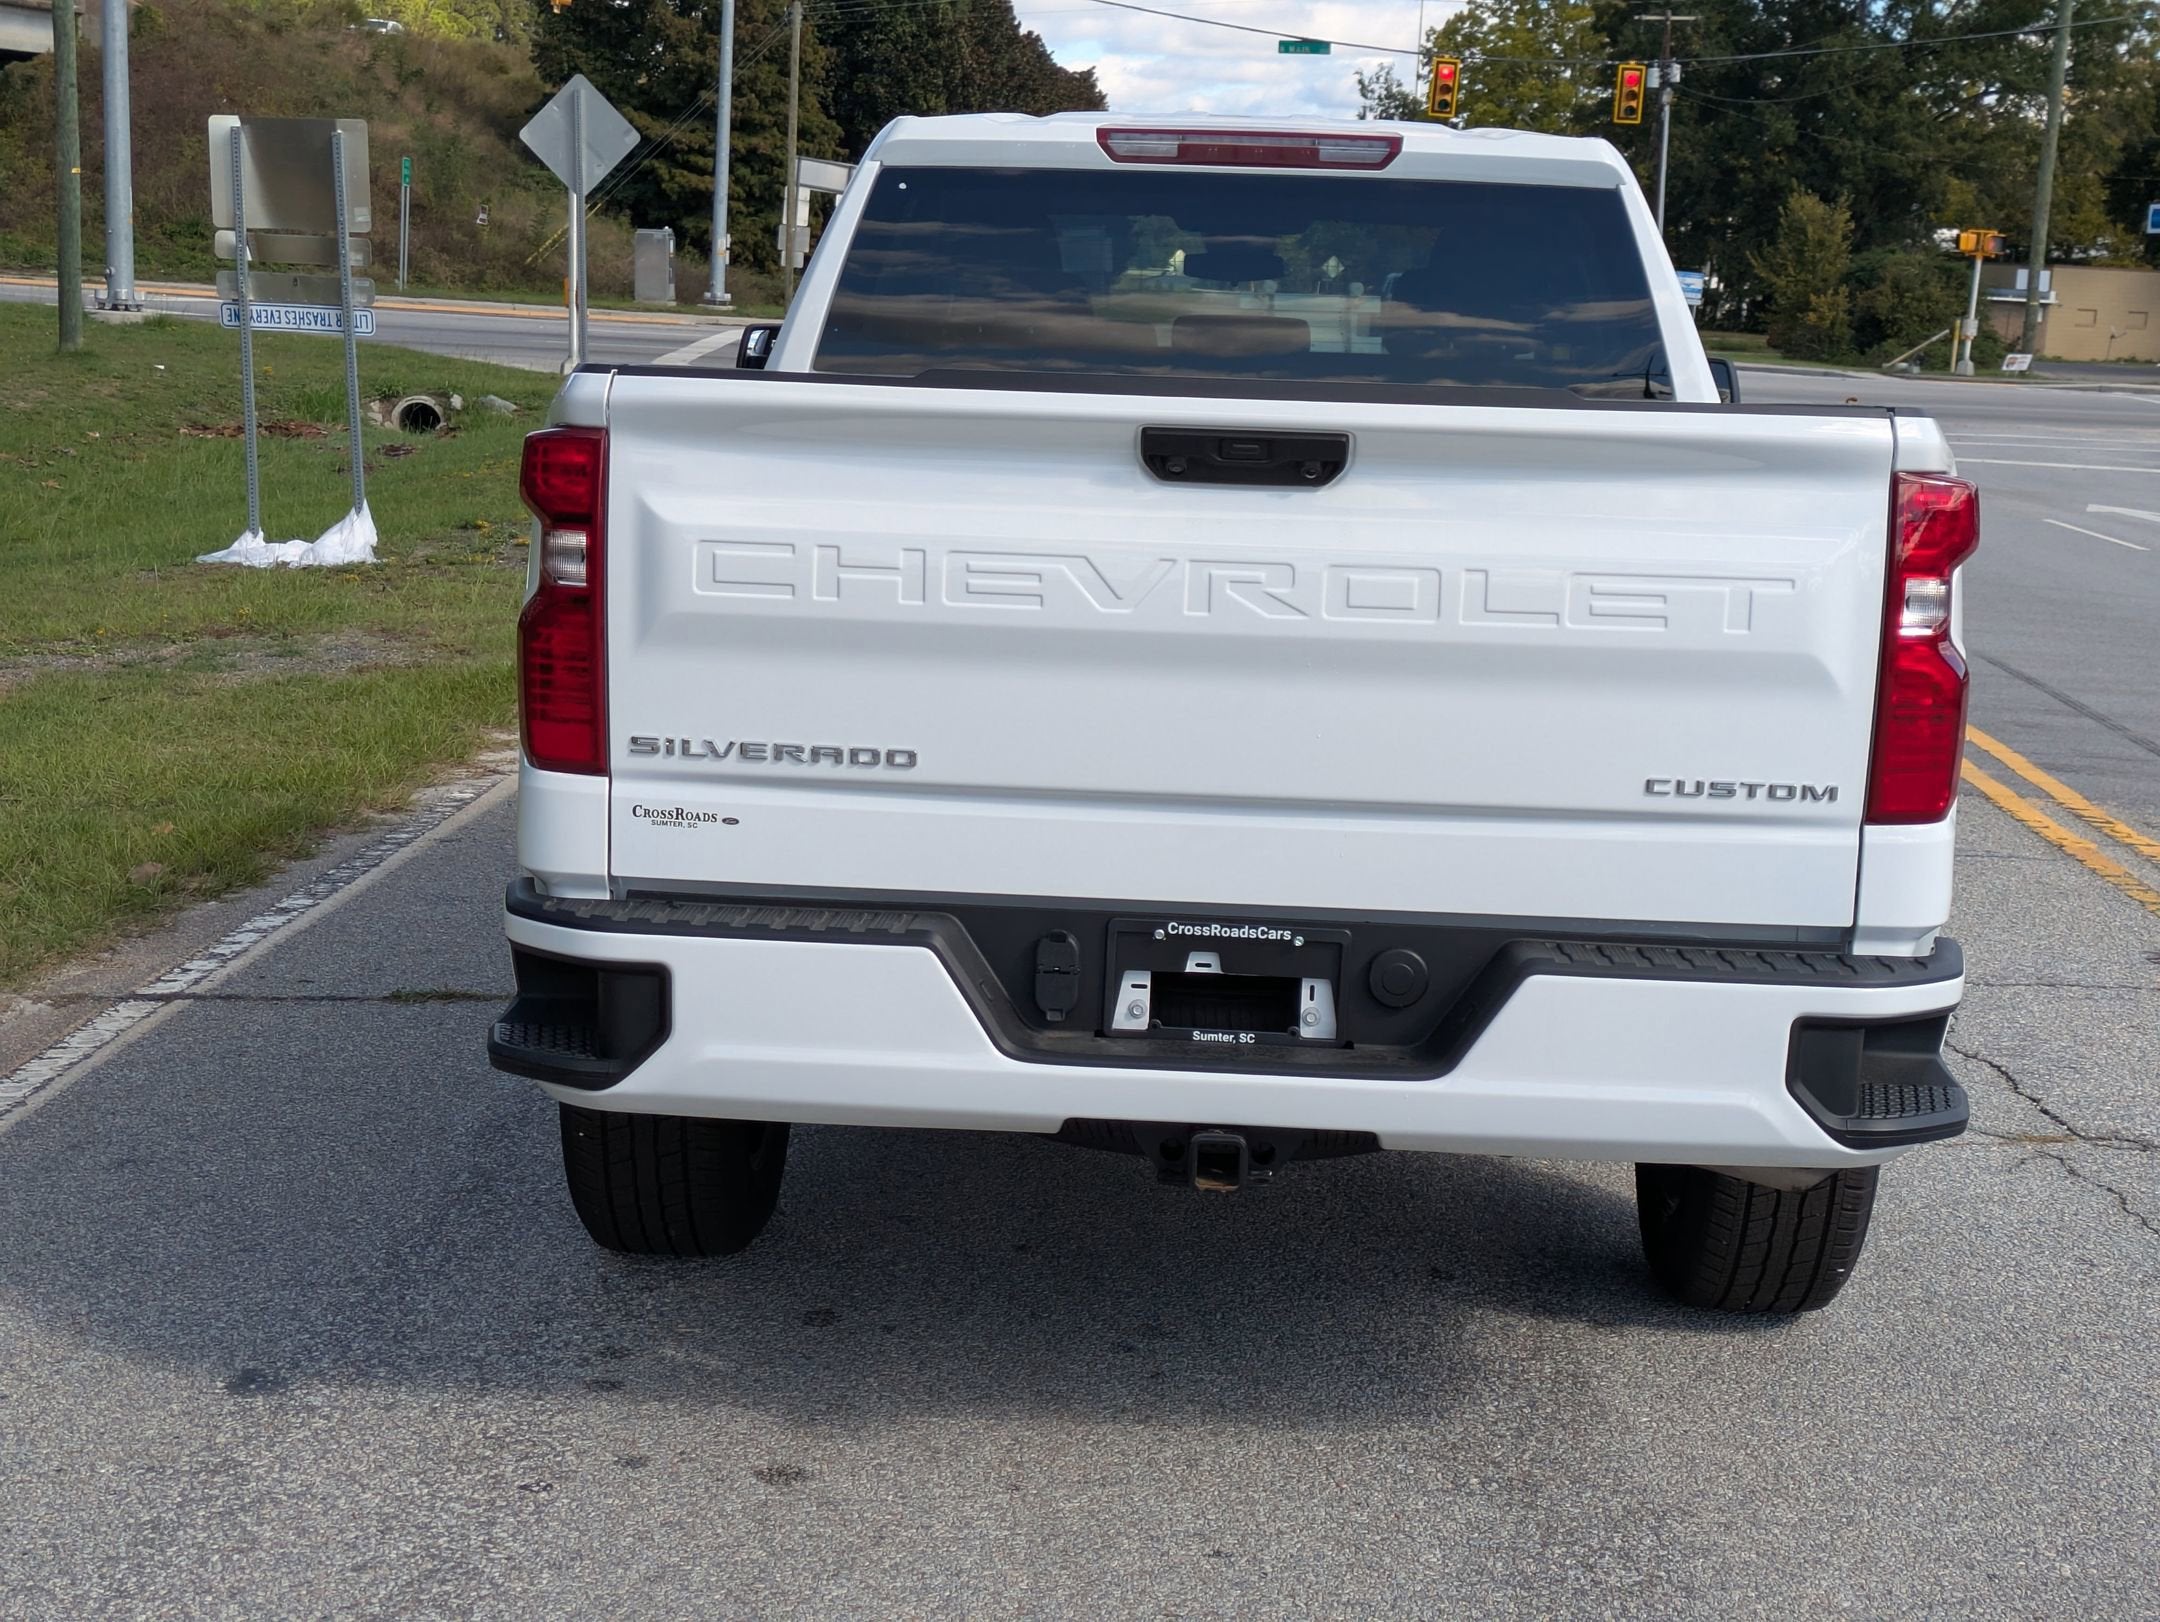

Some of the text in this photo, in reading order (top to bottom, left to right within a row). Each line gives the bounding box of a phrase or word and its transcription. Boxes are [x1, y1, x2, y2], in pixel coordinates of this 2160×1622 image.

[226, 307, 369, 329] LITR TRASHES EVERYNE
[693, 539, 1796, 635] CHEVROLET
[629, 736, 918, 768] SILVERADO
[1645, 778, 1839, 802] CUSTOM
[1167, 922, 1292, 941] CrossRoadsCars
[1192, 1031, 1256, 1044] Sumter, SC
